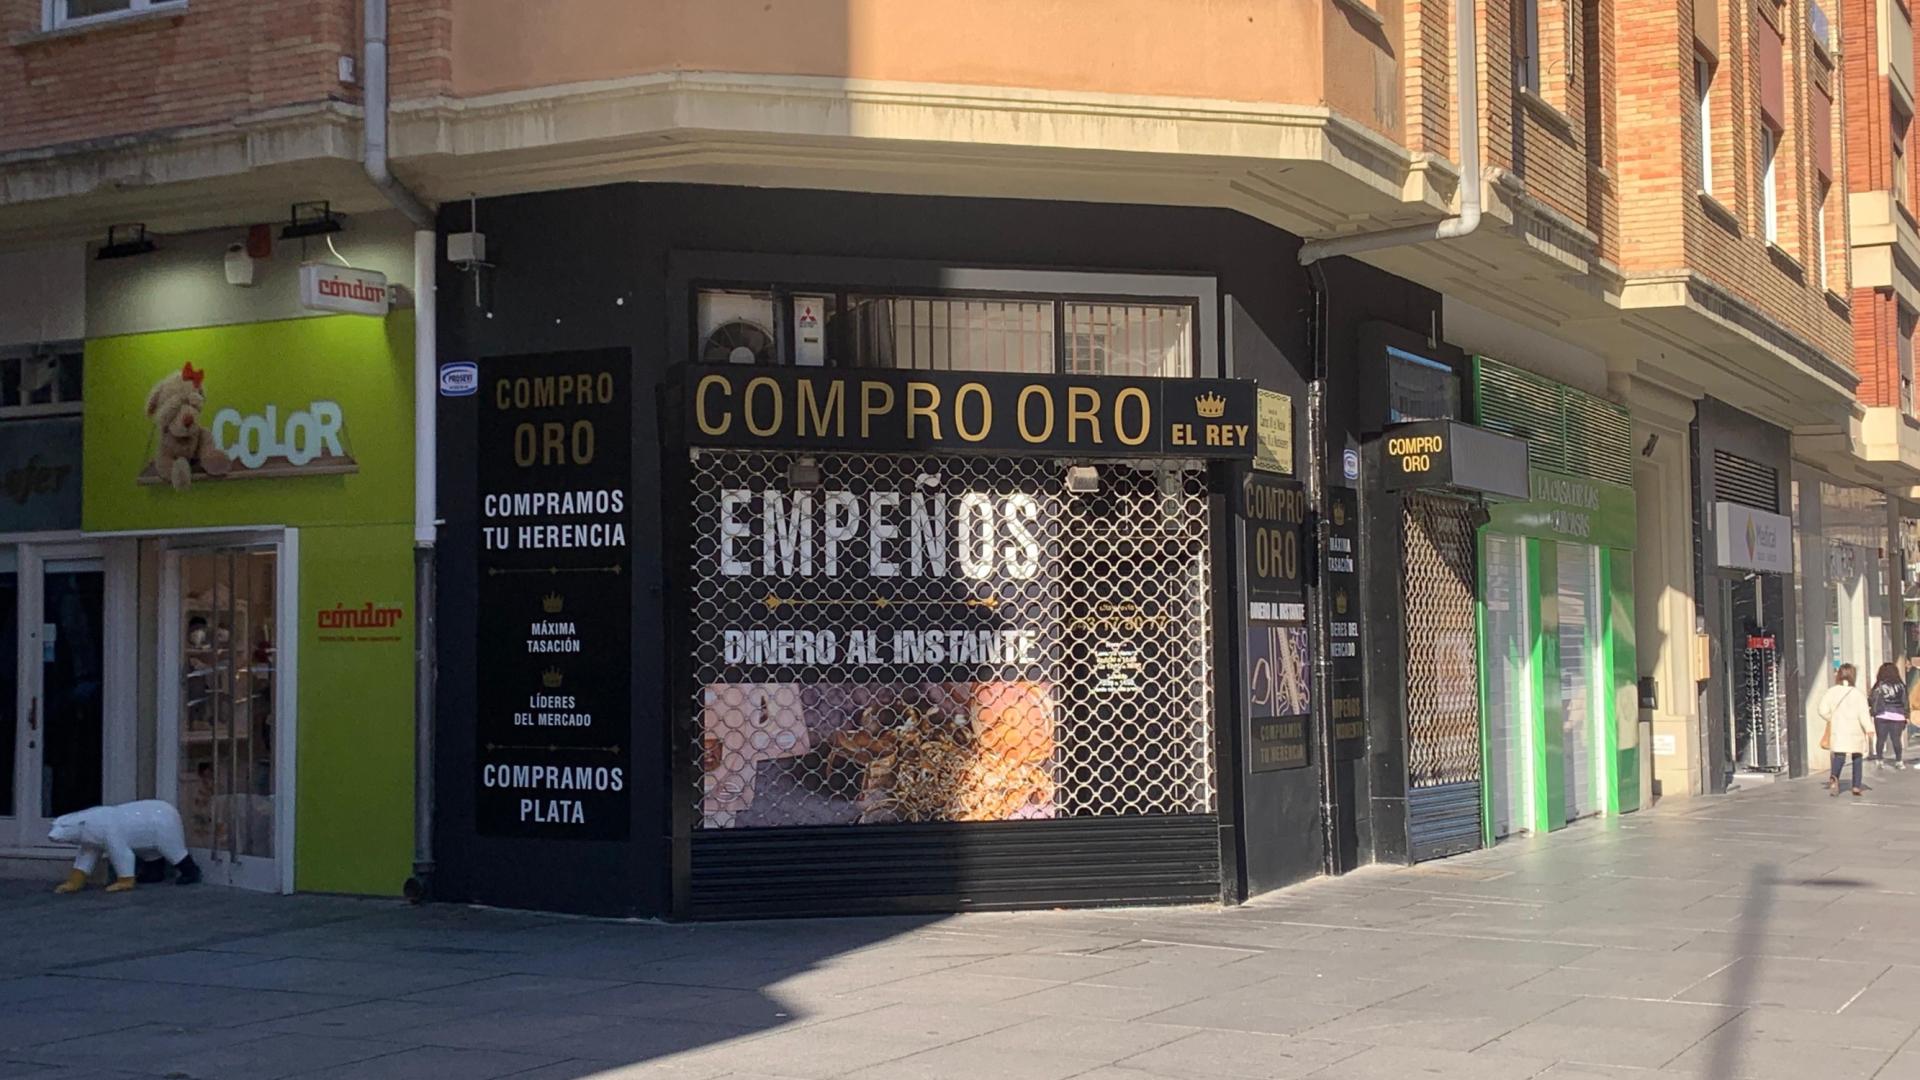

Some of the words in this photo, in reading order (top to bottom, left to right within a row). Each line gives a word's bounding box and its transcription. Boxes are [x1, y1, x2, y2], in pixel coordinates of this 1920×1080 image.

[319, 275, 386, 303] cóndor
[496, 372, 613, 410] COMPRO
[696, 374, 994, 442] COMPRO
[1017, 384, 1152, 446] ORO
[212, 401, 345, 469] COLOR
[514, 420, 594, 467] ORO
[1171, 423, 1198, 446] EL
[1206, 424, 1249, 447] REY
[1389, 435, 1442, 455] COMPRO
[1403, 455, 1430, 472] ORO
[485, 490, 624, 517] COMPRAMOS
[1246, 482, 1304, 524] COMPRO
[483, 527, 509, 549] TU
[519, 523, 626, 549] HERENCIA
[720, 473, 1038, 579] EMPEÑOS
[1256, 527, 1296, 580] ORO
[318, 602, 402, 628] cóndor
[531, 620, 576, 635] MÁXIMA
[527, 637, 580, 653] TASACIÓN
[724, 629, 836, 665] DINERO
[847, 629, 884, 665] AL
[894, 629, 1036, 665] INSTANTE
[530, 693, 576, 709] LÍDERES
[514, 713, 533, 726] DEL
[538, 713, 591, 727] MERCADO
[484, 764, 624, 791] COMPRAMOS
[520, 799, 585, 823] PLATA
